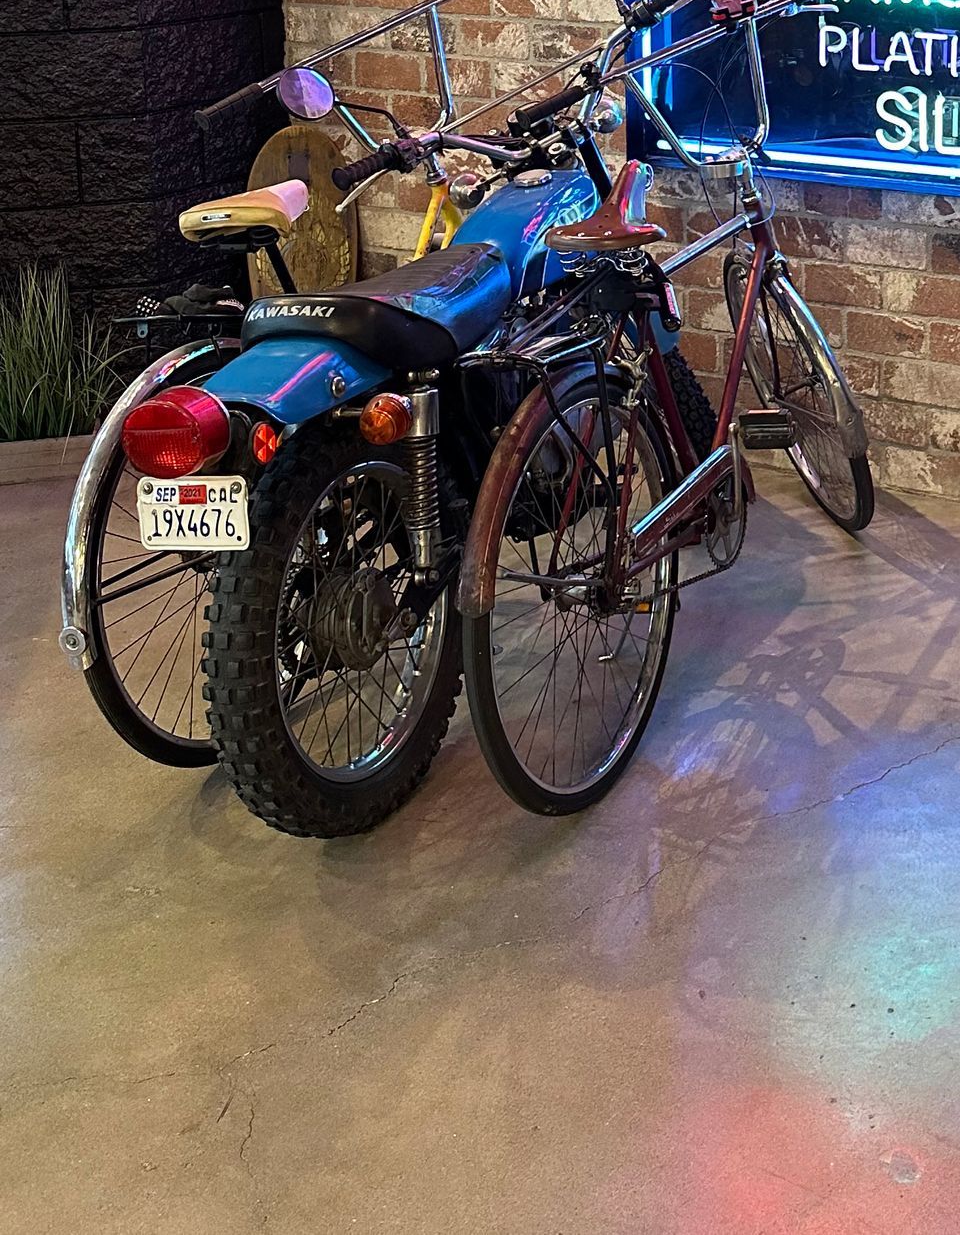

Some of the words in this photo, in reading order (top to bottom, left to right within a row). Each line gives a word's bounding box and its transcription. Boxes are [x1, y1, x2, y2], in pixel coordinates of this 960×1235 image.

[247, 306, 335, 322] KAWASAKI
[155, 488, 177, 502] SEP
[184, 489, 201, 497] 2021
[208, 488, 238, 503] CAL
[152, 509, 236, 537] 19X4676
